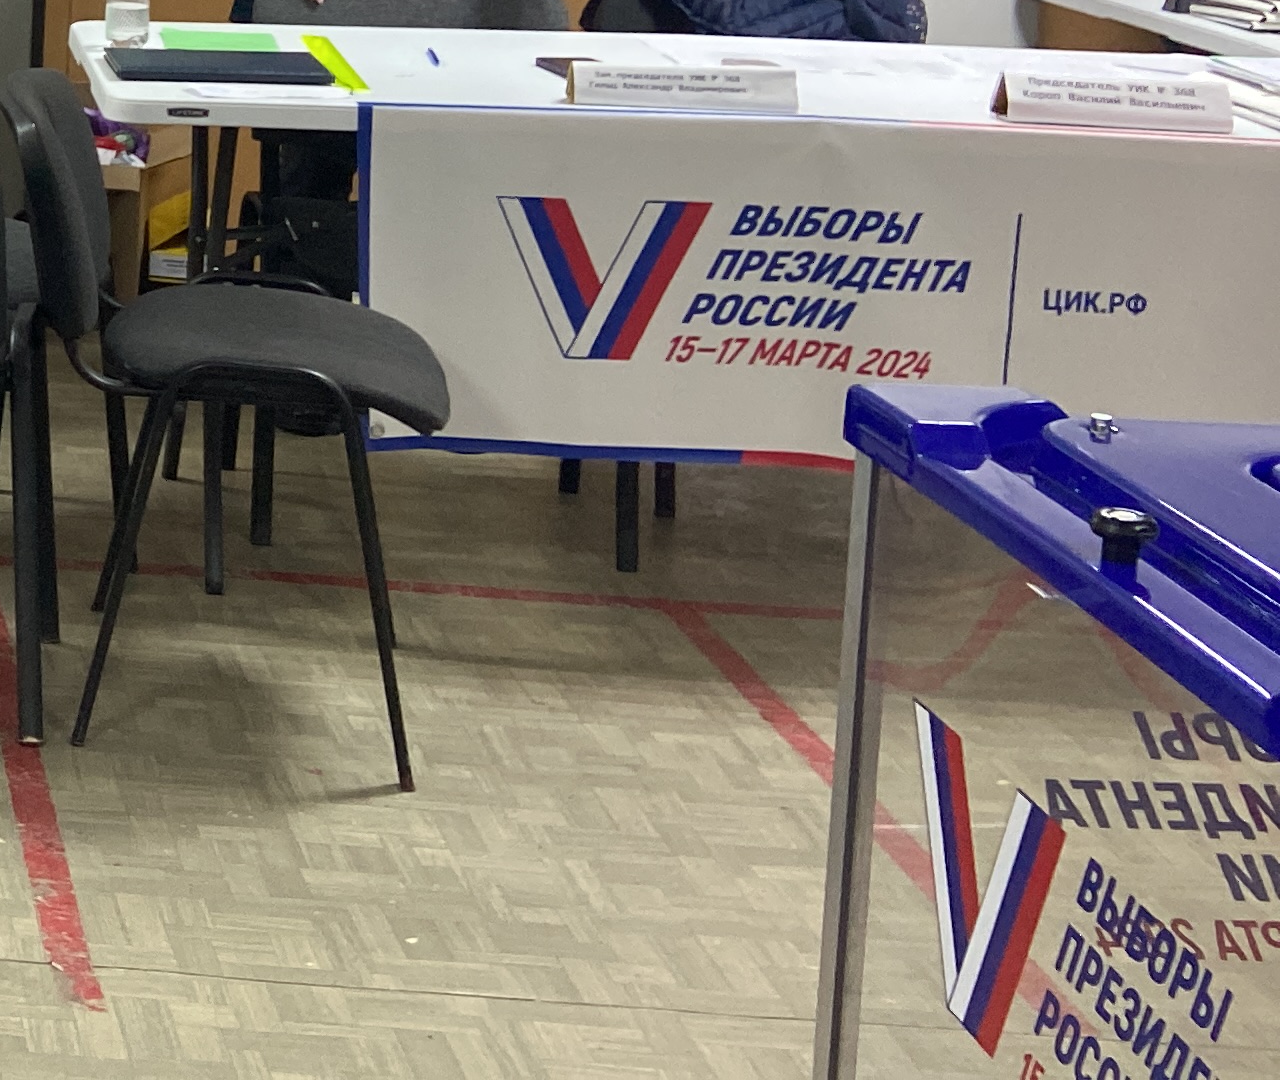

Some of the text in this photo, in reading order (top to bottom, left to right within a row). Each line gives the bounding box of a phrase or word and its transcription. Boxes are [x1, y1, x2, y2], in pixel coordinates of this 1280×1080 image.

[729, 204, 923, 246] ВЫБОРЫ
[705, 249, 972, 294] ПРЕЗИДЕНТА
[682, 294, 858, 332] РОССИИ
[1043, 288, 1148, 317] ЦИК.РФ
[751, 339, 853, 375] МАРТА
[856, 346, 934, 381] 2024
[1076, 857, 1234, 1043] ВЫБОРЫ
